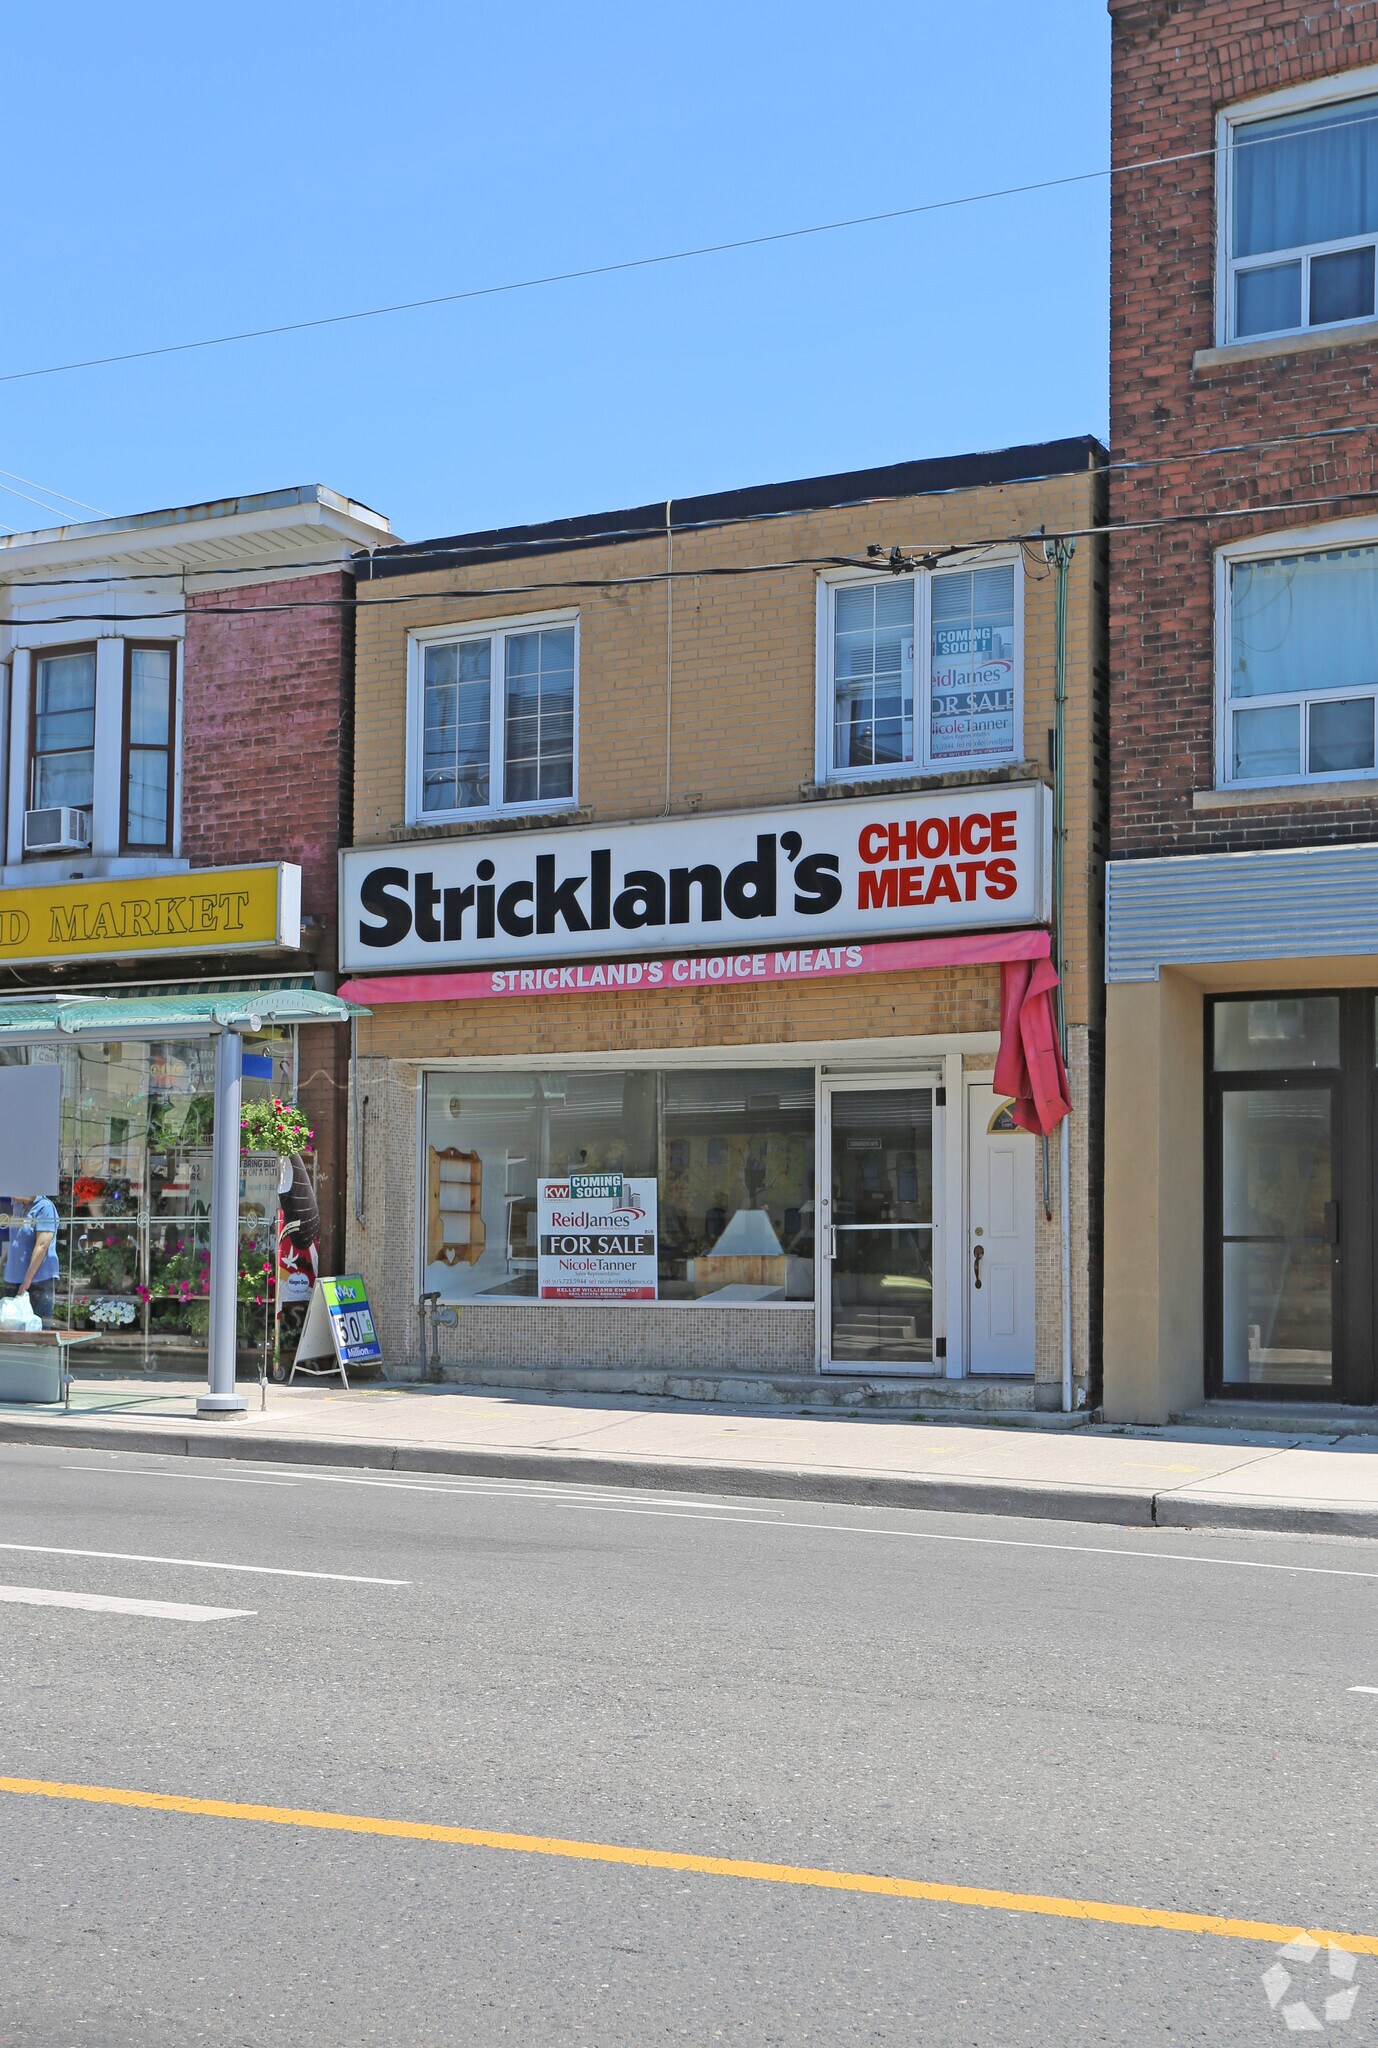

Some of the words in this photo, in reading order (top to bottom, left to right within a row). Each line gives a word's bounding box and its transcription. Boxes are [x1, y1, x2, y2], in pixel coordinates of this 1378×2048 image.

[938, 627, 991, 643] COMING
[942, 641, 977, 654] SOON
[932, 669, 1001, 689] eidJames
[932, 718, 1009, 735] icoleTanner
[858, 811, 1017, 863] CHOICE
[359, 831, 842, 948] Strickland's
[857, 858, 1017, 910] MEATS
[48, 891, 249, 943] MARKET
[491, 961, 664, 993] STRICKLAND'S
[672, 954, 766, 984] CHOICE
[774, 946, 864, 973] MEATS
[244, 1160, 262, 1168] BRING
[571, 1175, 621, 1188] COMING
[545, 1187, 569, 1198] KW
[576, 1187, 609, 1198] SOON
[552, 1211, 630, 1229] ReidJames
[550, 1236, 592, 1254] FOR
[598, 1236, 645, 1254] SALE
[559, 1258, 637, 1271] NicoleTanner
[335, 1284, 356, 1302] MAX
